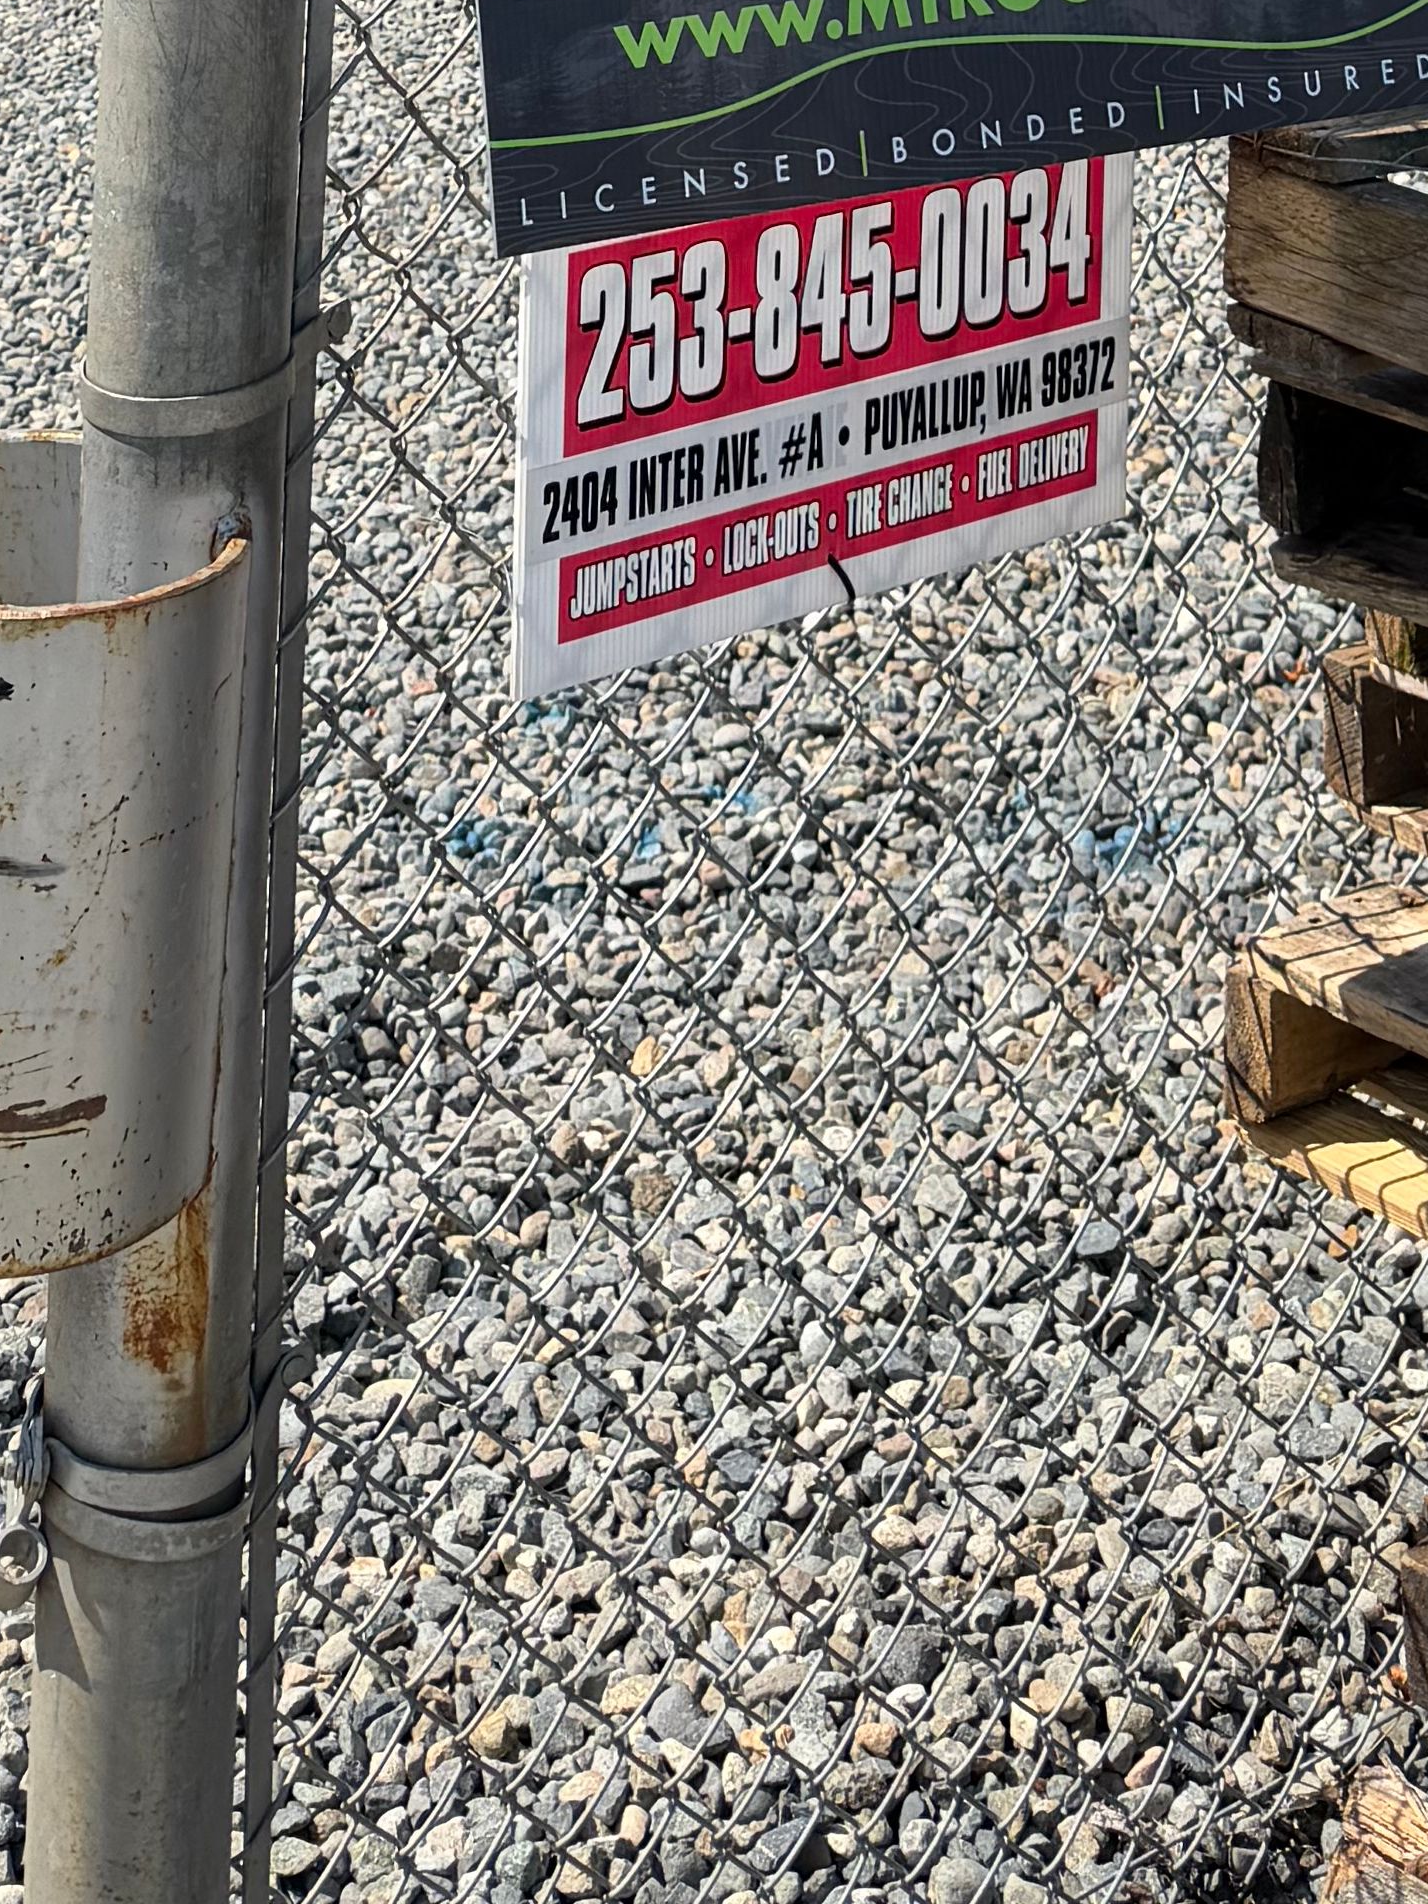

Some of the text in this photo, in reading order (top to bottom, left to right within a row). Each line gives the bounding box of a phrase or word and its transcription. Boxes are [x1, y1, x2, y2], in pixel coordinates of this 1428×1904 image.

[520, 146, 835, 226] LICENSED
[892, 101, 1125, 164] BONDED
[576, 158, 1094, 430] 253-845-0034
[542, 336, 1115, 544] 2404 INTER AVE. #A PUYALLUP, WA 98372
[569, 424, 1090, 622] JUMPSTARTS LOCK-OUTS TIRE CHANGE FUEL DELIVERY
